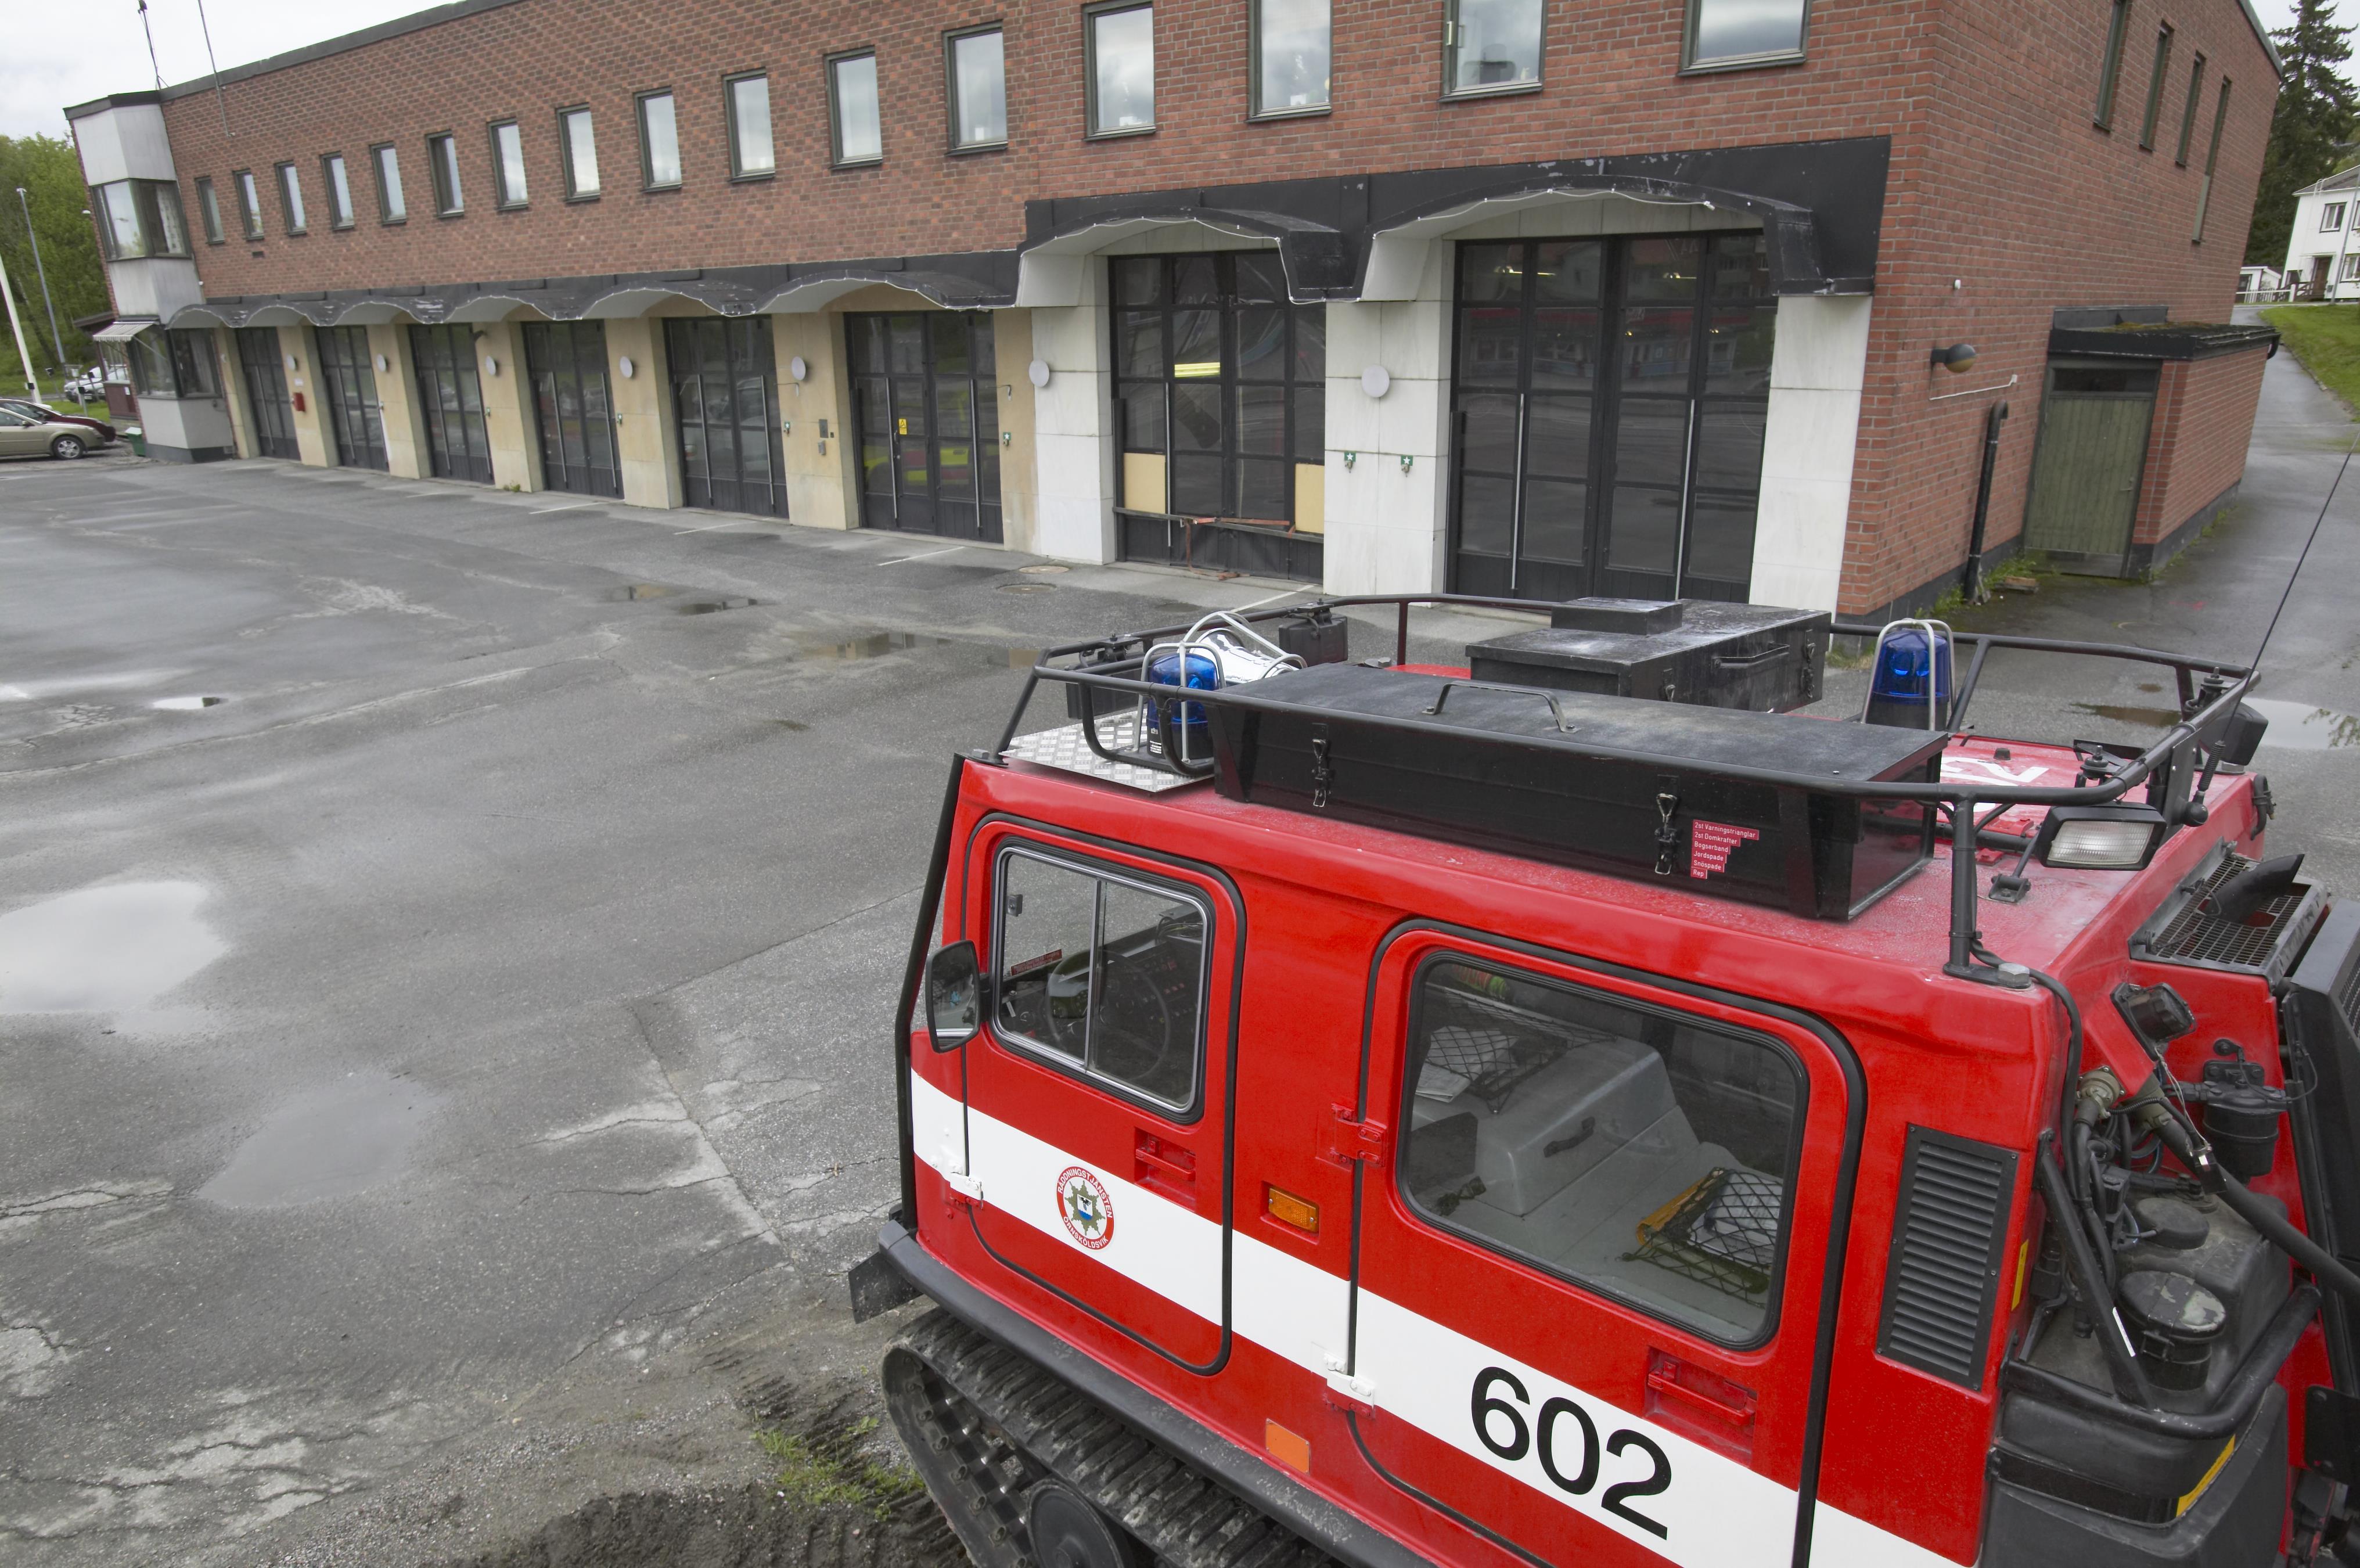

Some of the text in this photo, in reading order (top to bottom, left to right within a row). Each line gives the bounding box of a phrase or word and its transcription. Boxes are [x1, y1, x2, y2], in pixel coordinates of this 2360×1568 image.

[1705, 823, 1755, 838] Varningstrianglar
[1704, 833, 1737, 844] Domkrafter
[1694, 841, 1728, 853] Bogserband
[1693, 851, 1724, 861] Jordspade
[1693, 859, 1721, 871] Snöspade
[1693, 869, 1704, 877] Rep
[1057, 1168, 1113, 1218] RÄDDNINGSTJÄNSTEN
[1063, 1216, 1109, 1249] ÖRNSKÖLDSVIK
[1471, 1366, 1672, 1541] 602
